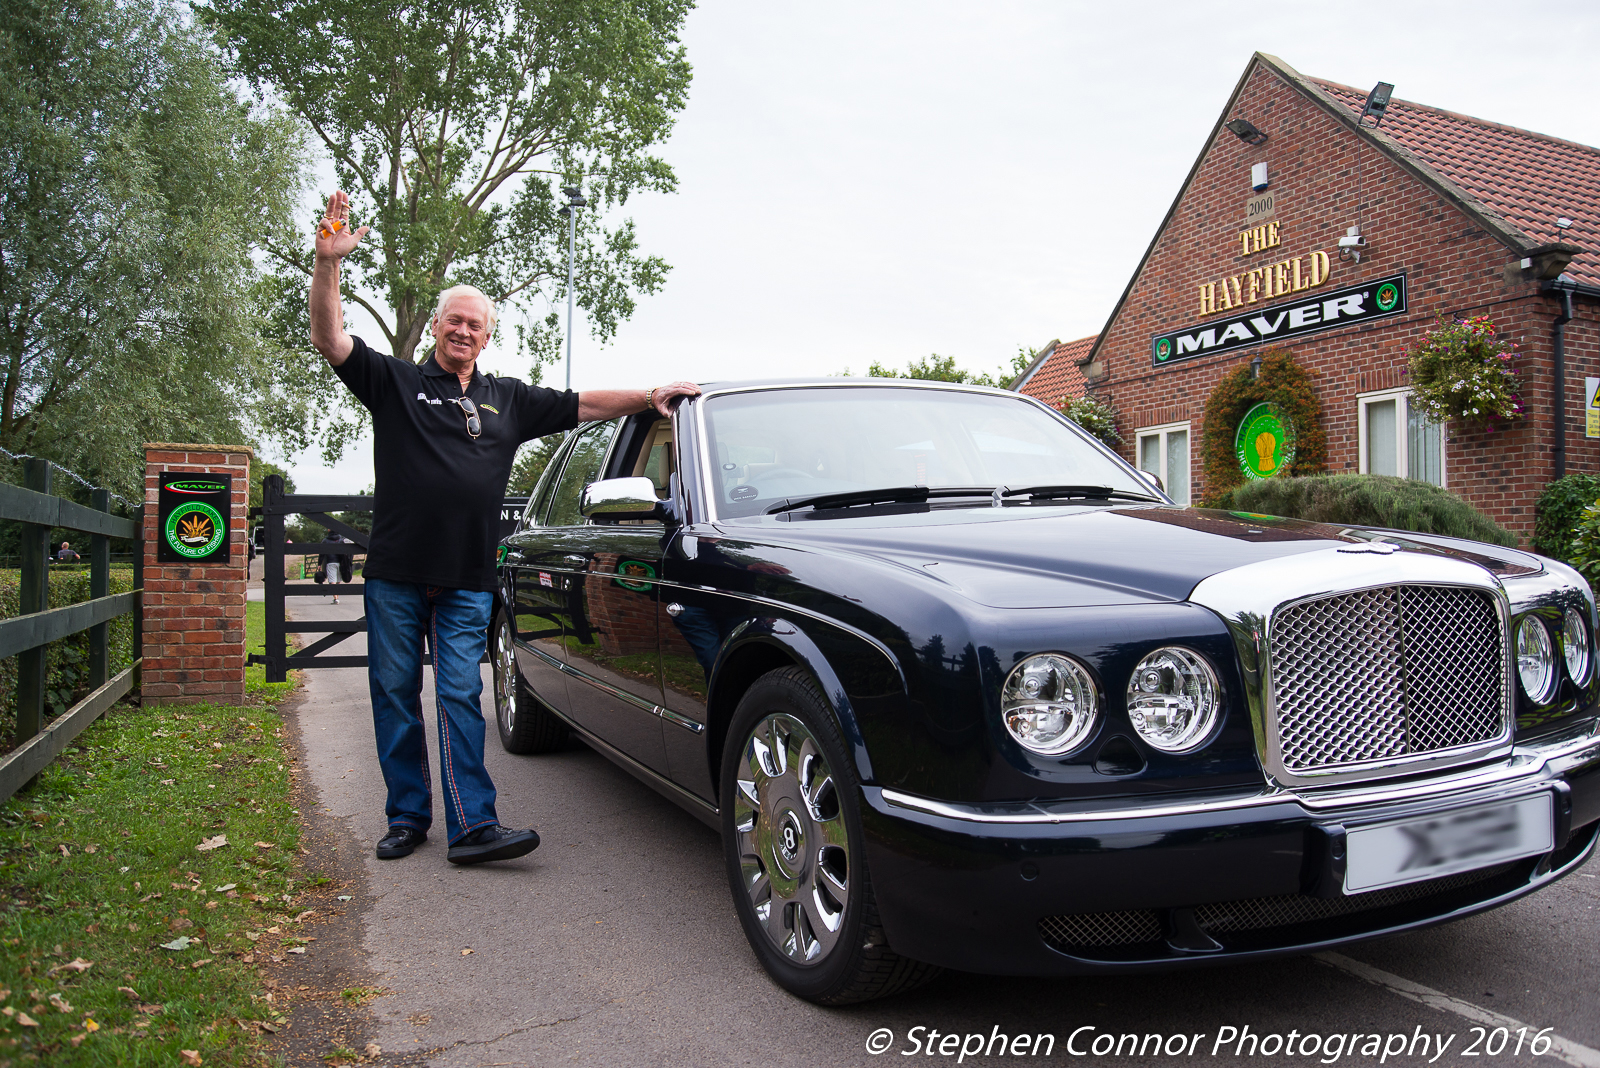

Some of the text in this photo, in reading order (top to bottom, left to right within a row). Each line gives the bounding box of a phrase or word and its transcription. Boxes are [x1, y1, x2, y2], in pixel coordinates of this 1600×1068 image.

[1249, 196, 1273, 217] 2000
[1239, 220, 1281, 257] THE
[1198, 250, 1331, 317] HAYFIELD
[1238, 449, 1247, 467] THE
[171, 505, 221, 525] HAYFIELD LAKES
[168, 529, 177, 541] THE
[173, 539, 197, 555] FUTURE
[206, 528, 222, 550] FISHING
